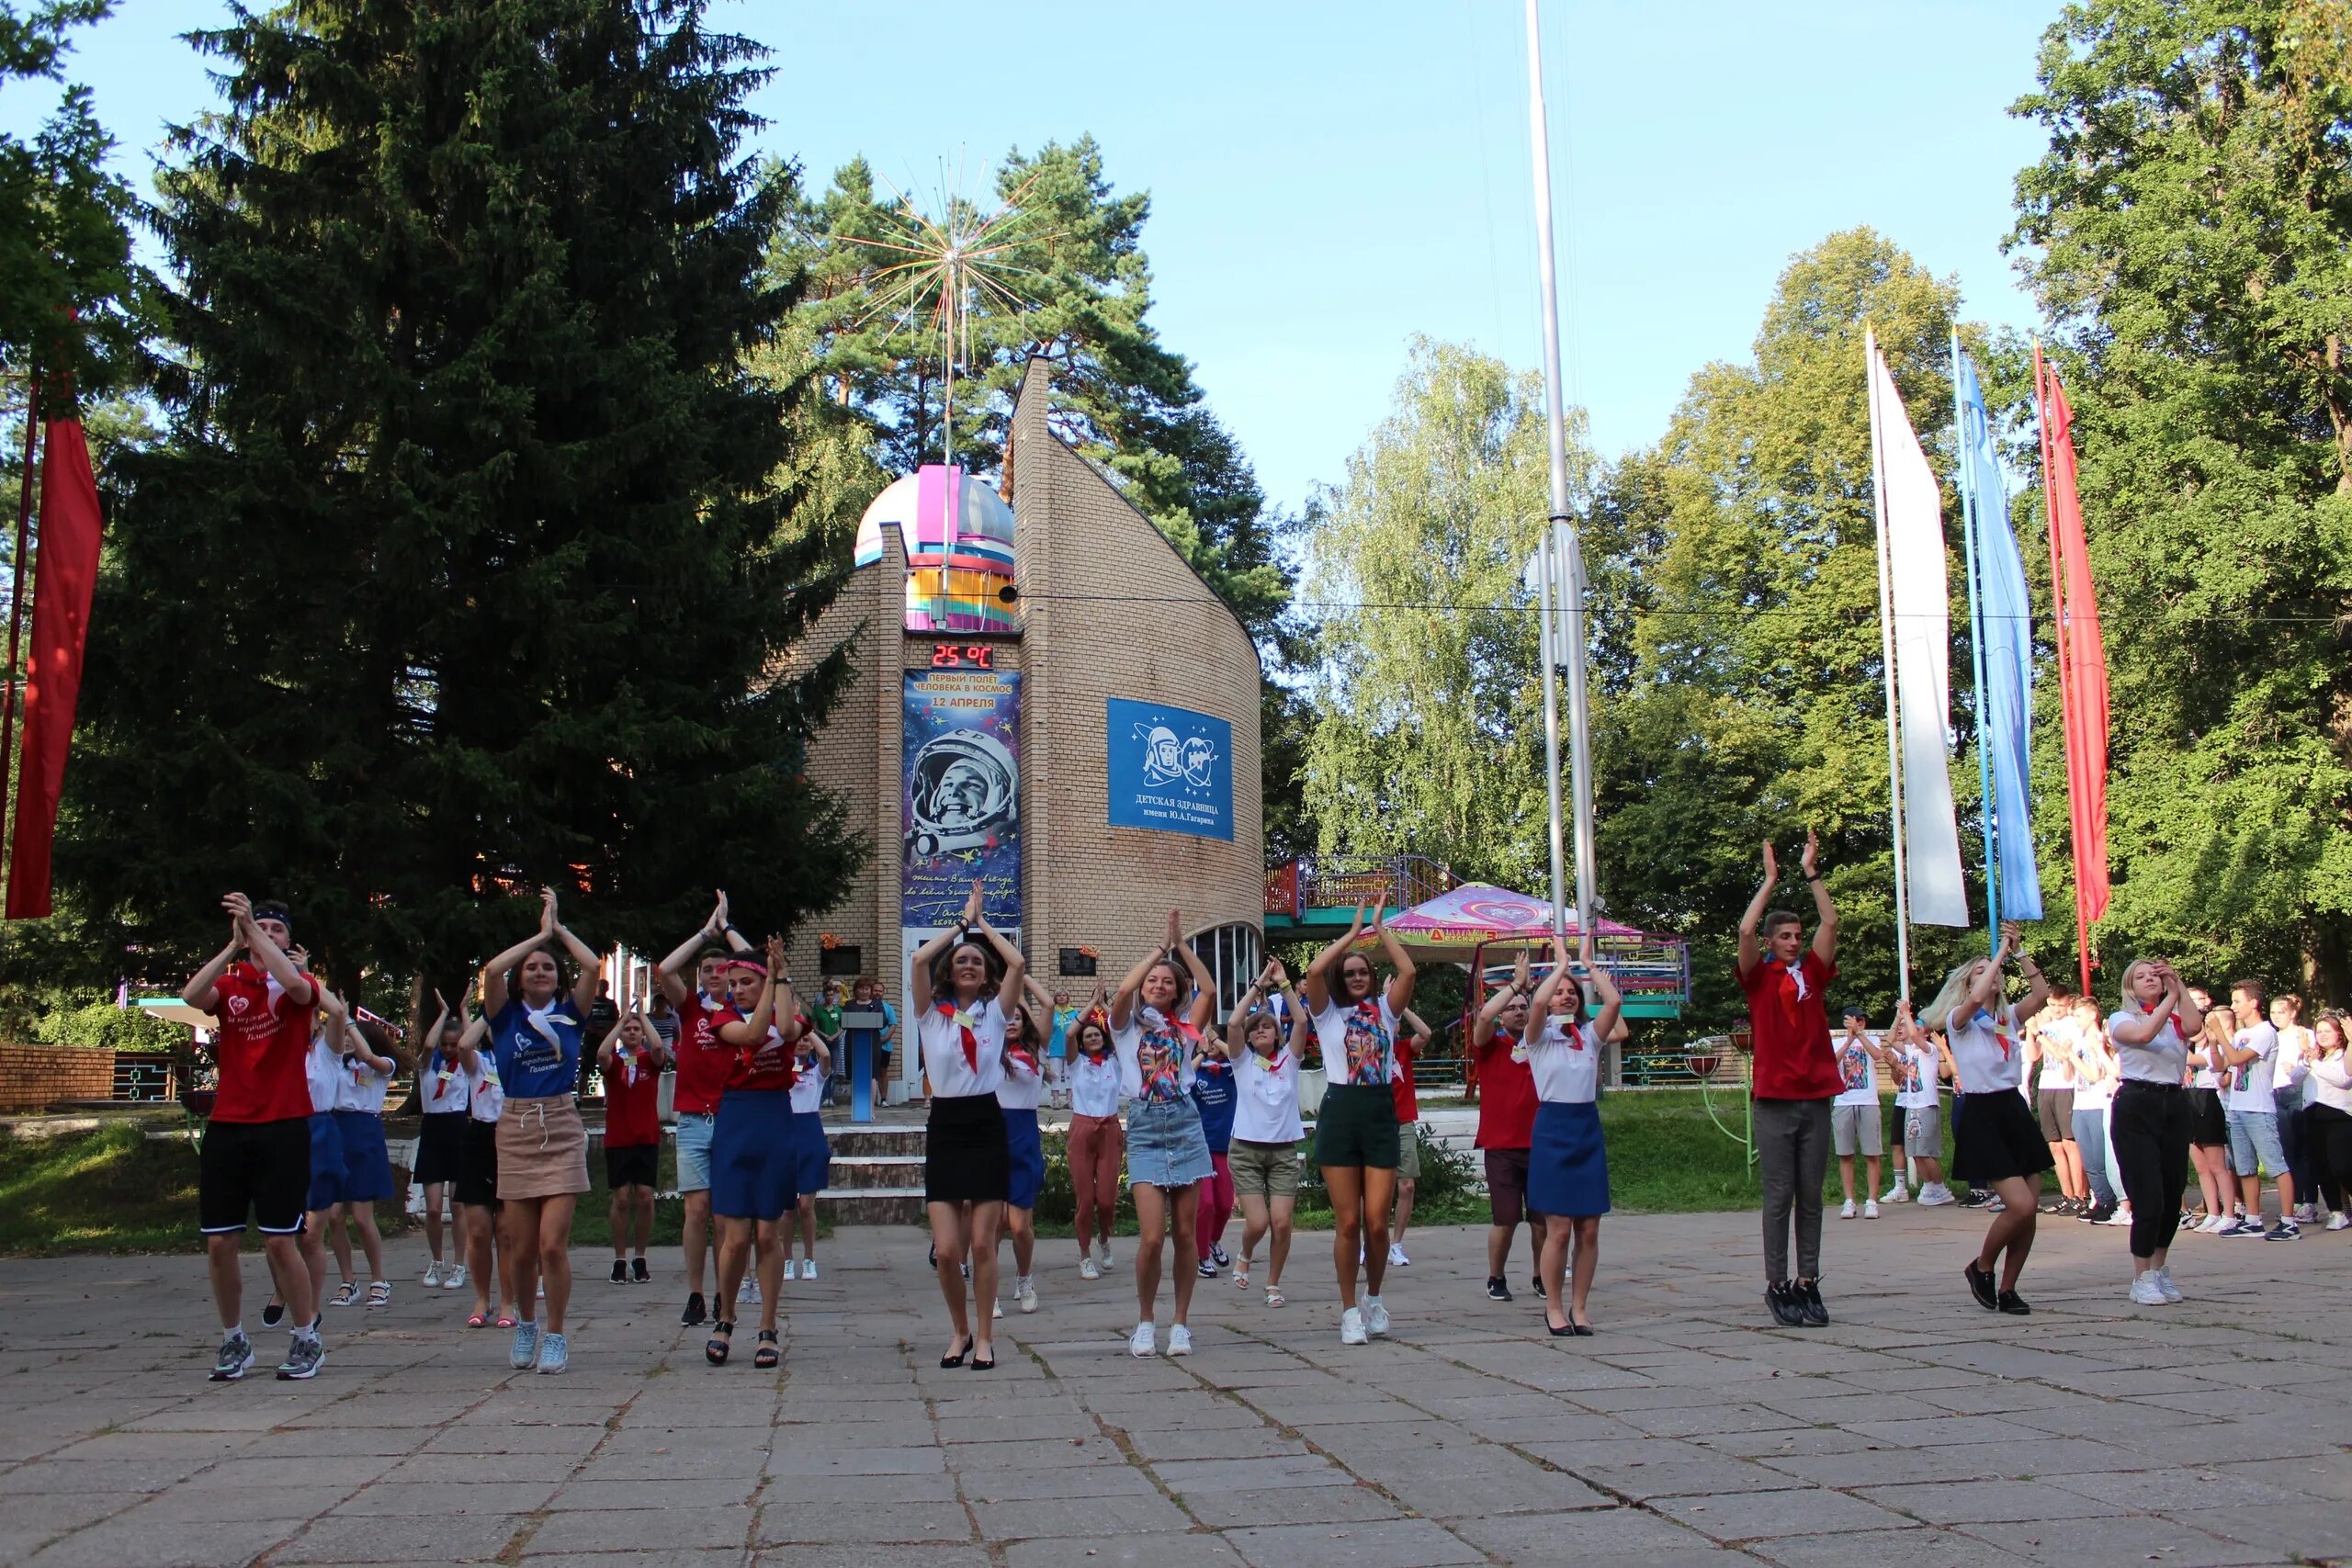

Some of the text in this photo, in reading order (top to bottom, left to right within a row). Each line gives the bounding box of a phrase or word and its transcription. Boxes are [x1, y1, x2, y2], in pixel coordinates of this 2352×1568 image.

[933, 645, 960, 666] 25
[929, 671, 967, 682] ПЕРВЫЙ
[914, 682, 1012, 694] ЧЕЛОВЕКА В КОСМОС
[933, 697, 994, 707] 12 АПРЕЛЯ
[1136, 794, 1219, 815] ДЕТСКАЯ ЗДРАВНИЦА
[1143, 808, 1168, 818] имени
[1430, 929, 1481, 942] Детская
